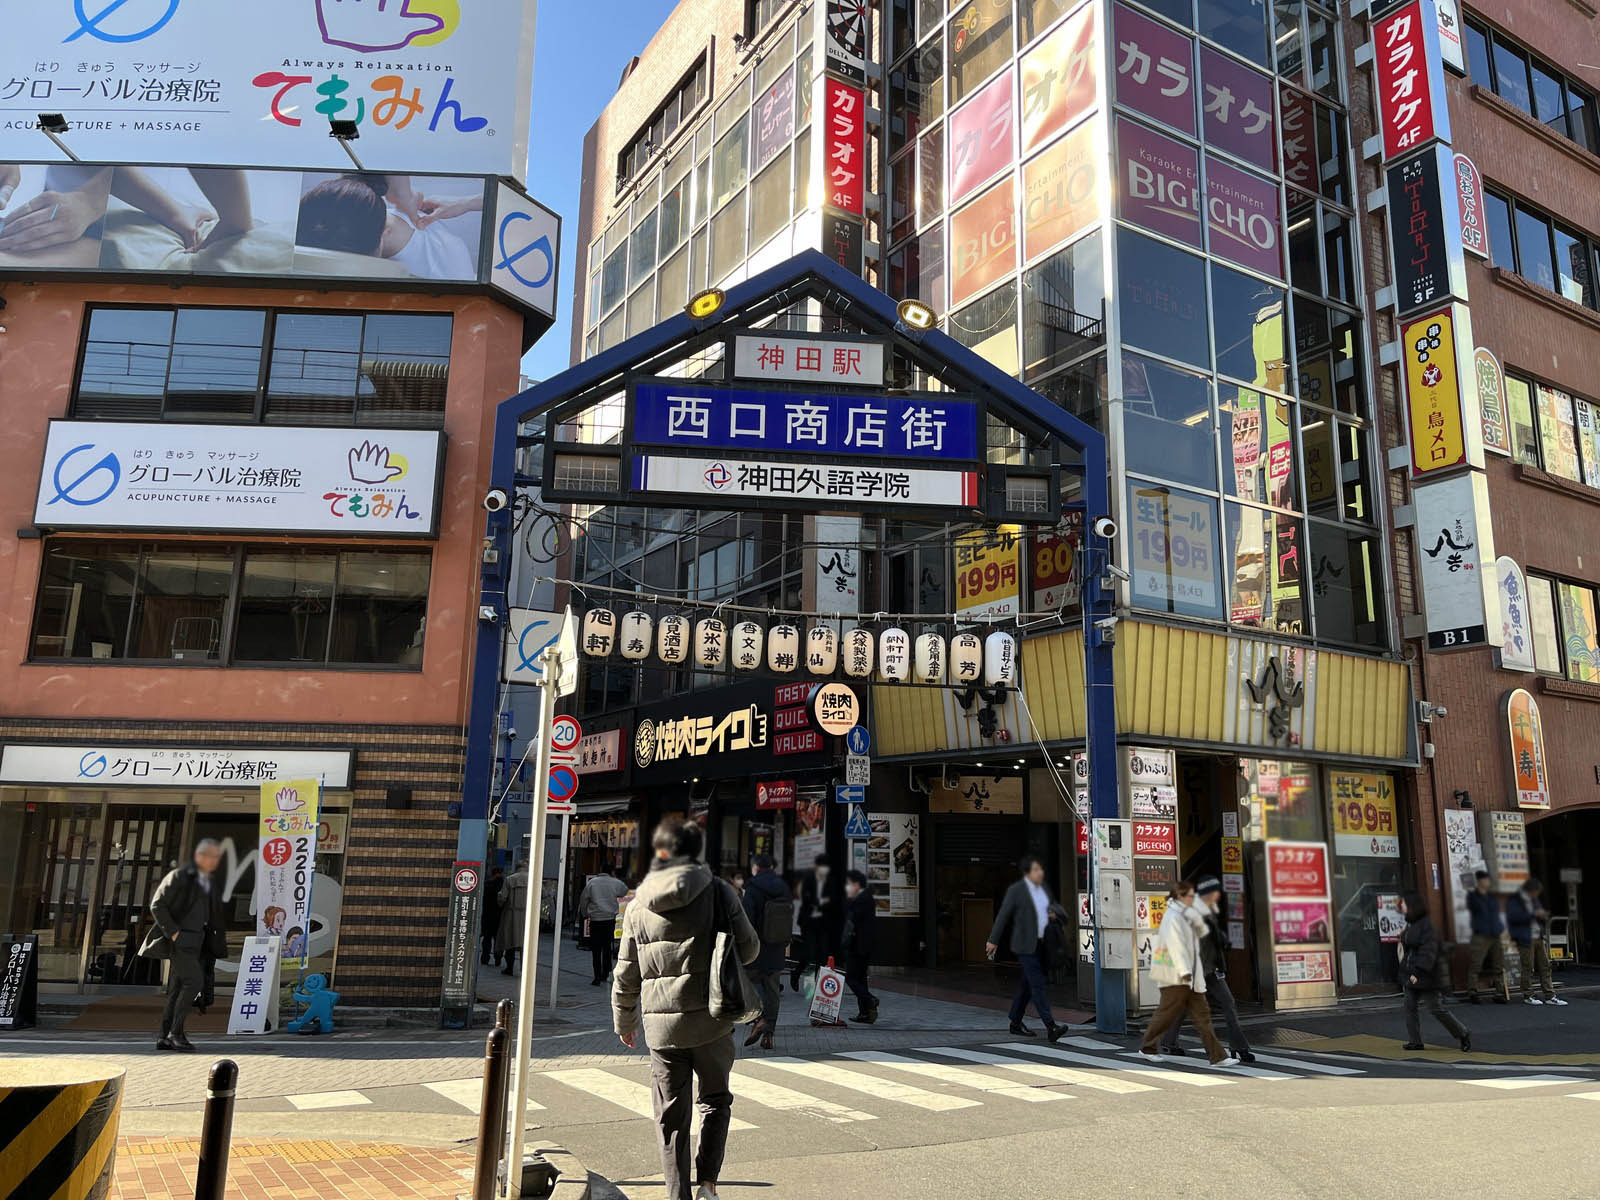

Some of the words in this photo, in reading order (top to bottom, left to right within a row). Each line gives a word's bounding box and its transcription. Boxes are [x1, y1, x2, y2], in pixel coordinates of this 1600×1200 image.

[282, 57, 347, 70] Always
[354, 59, 455, 72] Relaxation
[829, 47, 849, 60] DELTA
[34, 62, 60, 73] はり
[76, 62, 116, 74] きゅう
[132, 62, 201, 74] マッサージ
[839, 63, 853, 76] 5F
[1386, 14, 1422, 130] カラオケ
[1, 77, 221, 104] グローバル治療院
[1118, 40, 1272, 134] カラオケ
[252, 71, 488, 131] てもみん
[954, 40, 1095, 173] カラオケ
[133, 121, 202, 132] MASSAGE
[831, 88, 856, 187] カラオケ
[1397, 126, 1421, 148] 4F
[1139, 147, 1182, 175] Karaoke
[832, 192, 853, 207] 4F
[1462, 227, 1481, 248] 4F
[1413, 286, 1435, 304] 3F
[756, 342, 863, 376] 神田駅
[666, 395, 948, 452] 西口商店街
[1484, 424, 1503, 446] 3F
[1426, 410, 1448, 462] 鳥メロ
[133, 449, 153, 460] はり
[165, 450, 194, 461] きゅう
[207, 451, 260, 462] マッサージ
[127, 463, 303, 489] グローバル治療院
[737, 463, 911, 498] 神田外語学院
[127, 494, 211, 503] ACUPUNCTURE
[225, 495, 278, 504] MASSAGE
[322, 492, 420, 519] てもみん
[1137, 528, 1209, 572] 199円
[957, 559, 1018, 599] 199円
[587, 608, 613, 653] 旭軒
[627, 613, 647, 653] 千寿
[703, 619, 722, 662] 旭氷業
[1443, 629, 1470, 646] B1
[895, 636, 904, 664] NTT
[960, 634, 977, 676] 高芳
[821, 692, 853, 710] 焼肉
[776, 709, 808, 729] QUIC
[821, 709, 846, 721] ライク
[554, 725, 575, 742] 20
[655, 708, 751, 762] 焼肉ライク
[776, 731, 817, 753] VALUE!
[1513, 712, 1534, 779] 千寿
[110, 759, 278, 781] グローバル治療院
[1335, 777, 1391, 801] 生ビール
[263, 815, 315, 834] てもみん
[1337, 801, 1393, 833] 199円
[1135, 824, 1170, 837] カラオケ
[268, 842, 286, 856] 15
[1136, 841, 1151, 851] BIG
[1152, 841, 1172, 852] ECHO
[272, 855, 283, 865] 分
[240, 955, 269, 1020] 営業中
